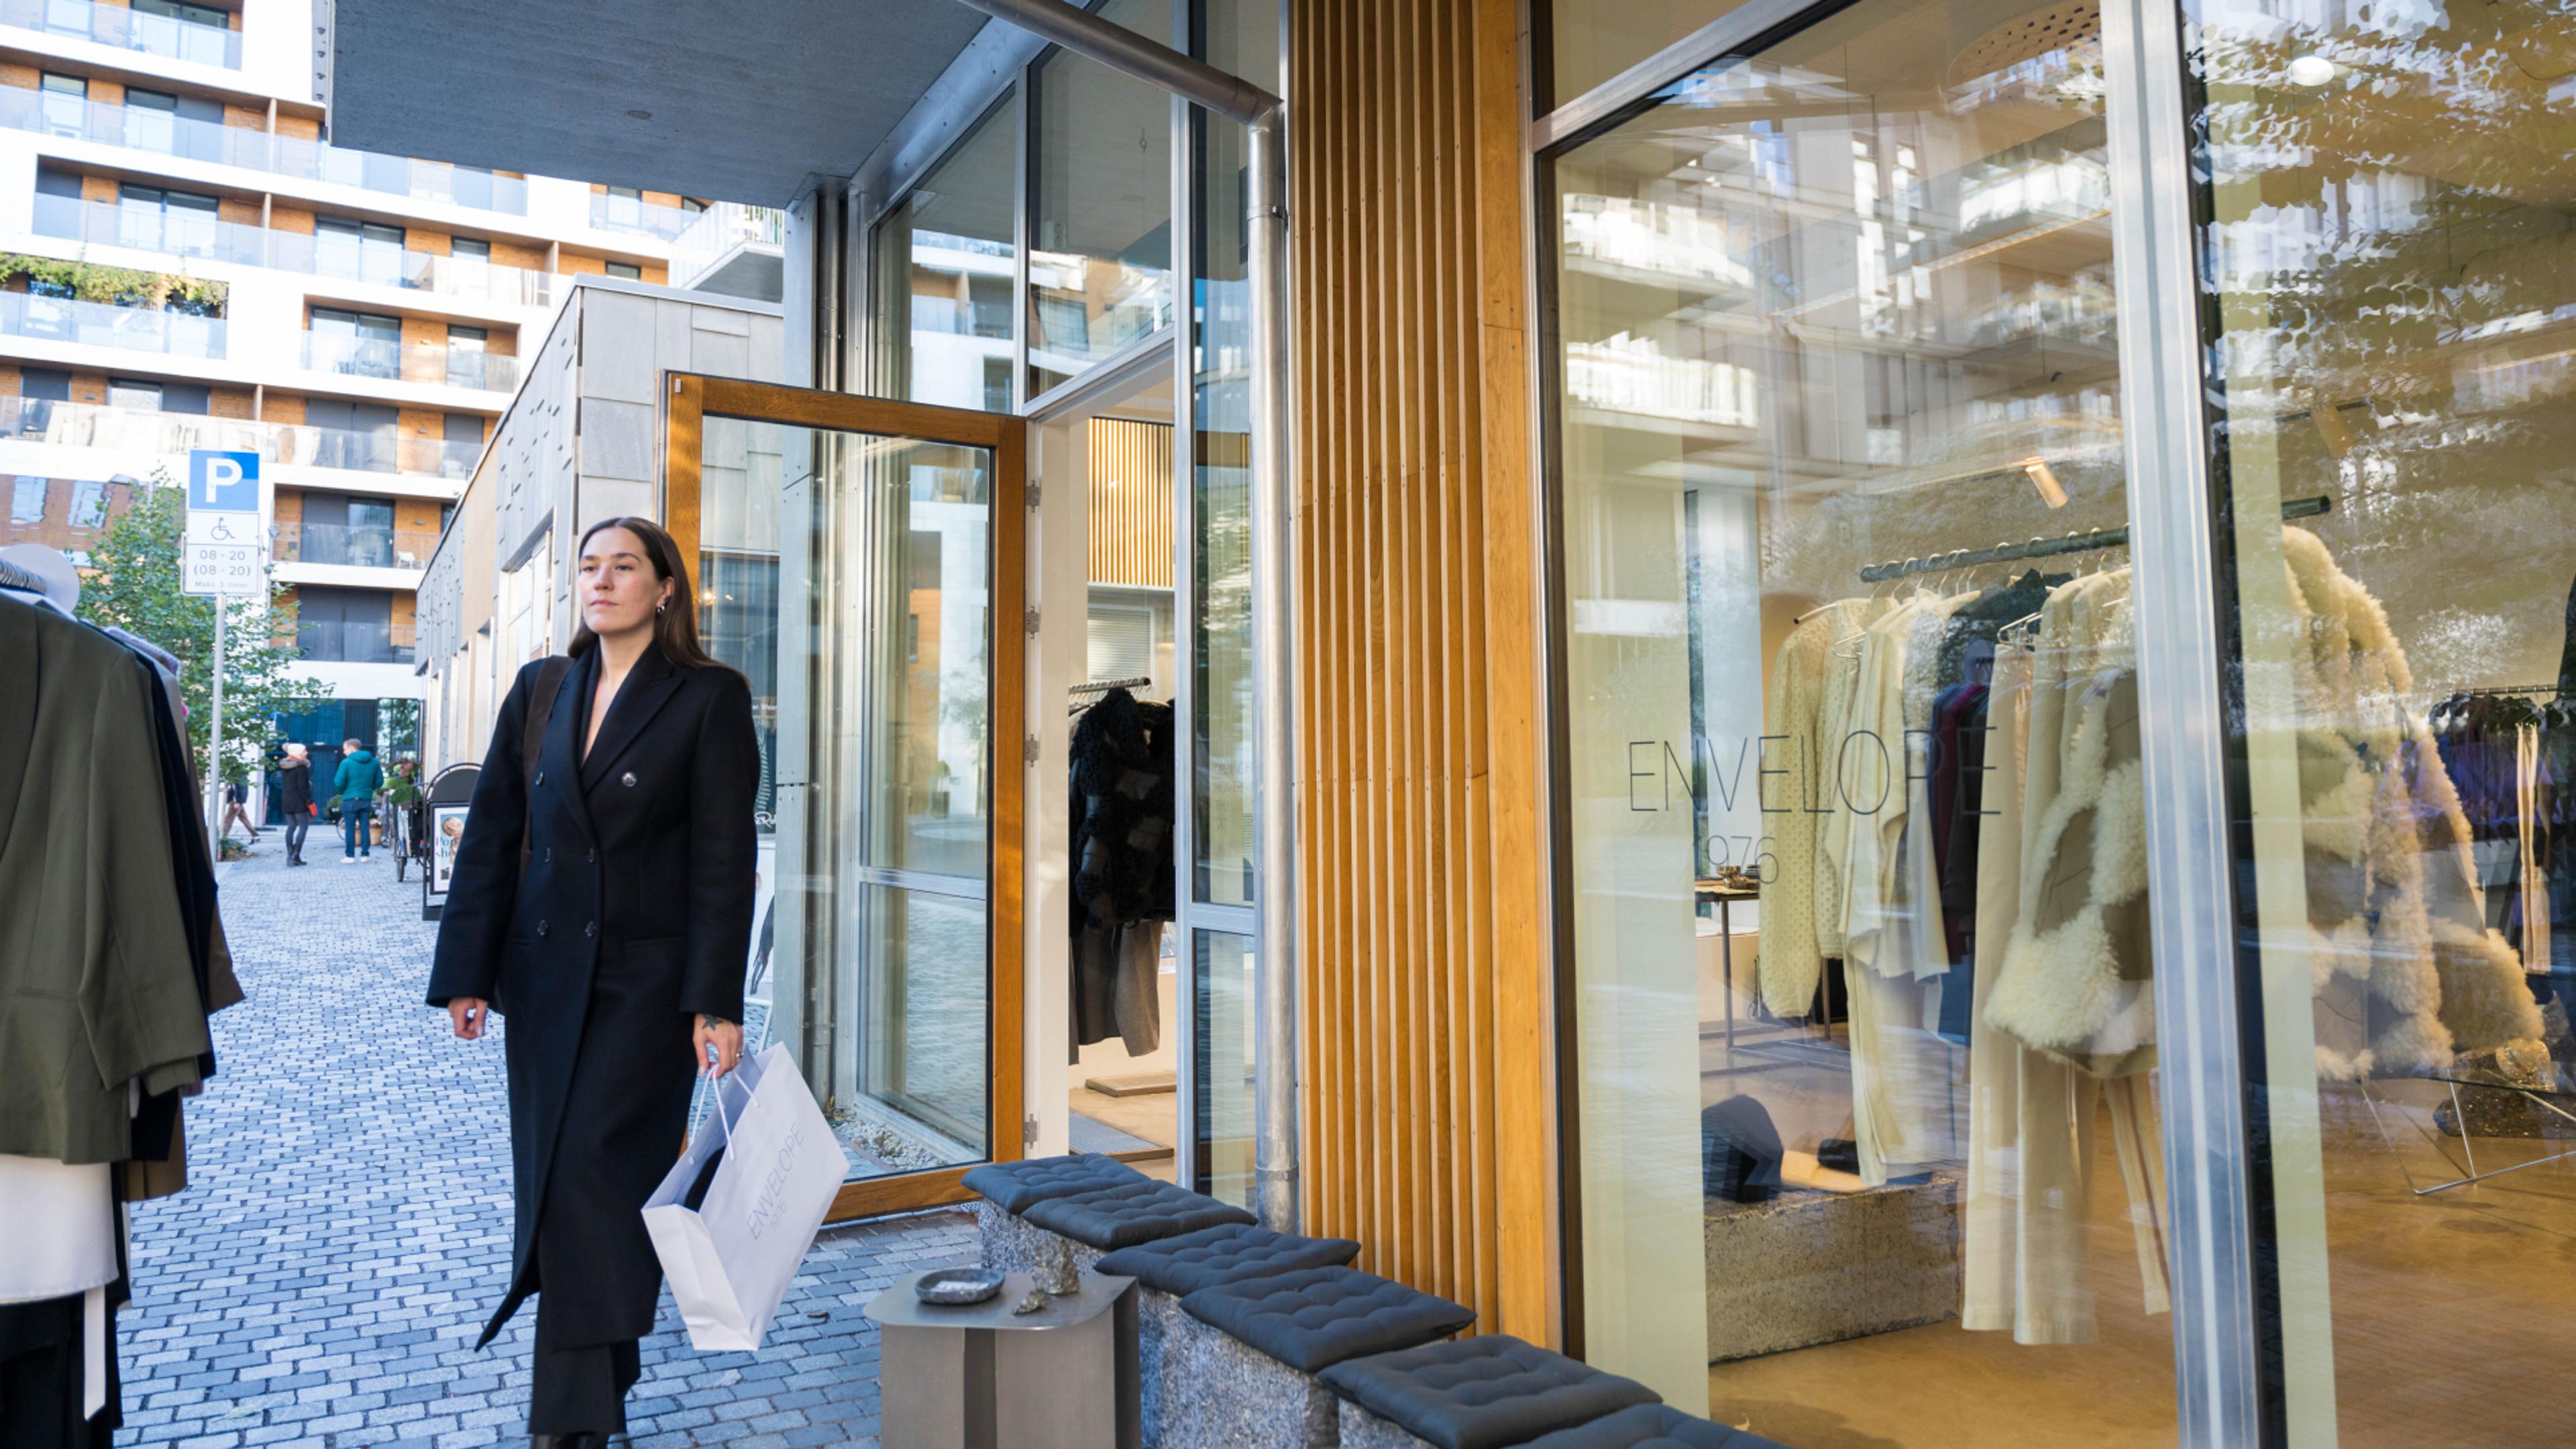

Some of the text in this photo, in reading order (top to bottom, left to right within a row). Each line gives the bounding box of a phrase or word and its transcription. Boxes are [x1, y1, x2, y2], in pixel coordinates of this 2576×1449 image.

[206, 458, 243, 502] P
[194, 564, 217, 576] (08
[229, 566, 251, 577] 20)
[199, 549, 217, 560] 08
[229, 550, 246, 561] 20
[1629, 727, 2001, 816] ENVELOPE
[1693, 835, 1779, 885] 1976
[746, 1122, 805, 1240] ENVELOPE
